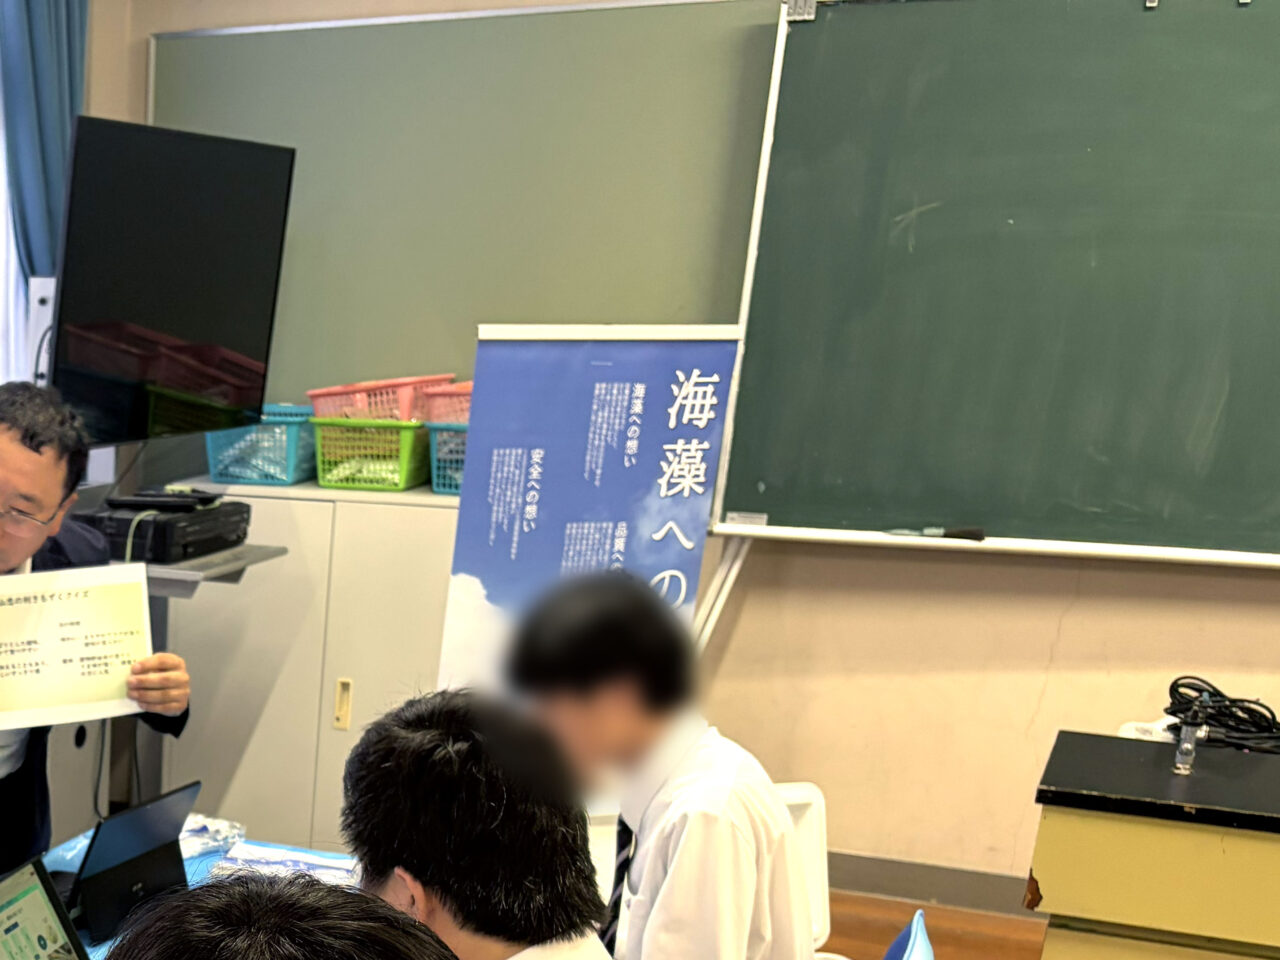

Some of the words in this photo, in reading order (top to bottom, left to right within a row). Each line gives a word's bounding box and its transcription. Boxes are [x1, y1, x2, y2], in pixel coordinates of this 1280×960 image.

[523, 448, 545, 533] 安全への想い
[649, 368, 720, 609] 海藻への
